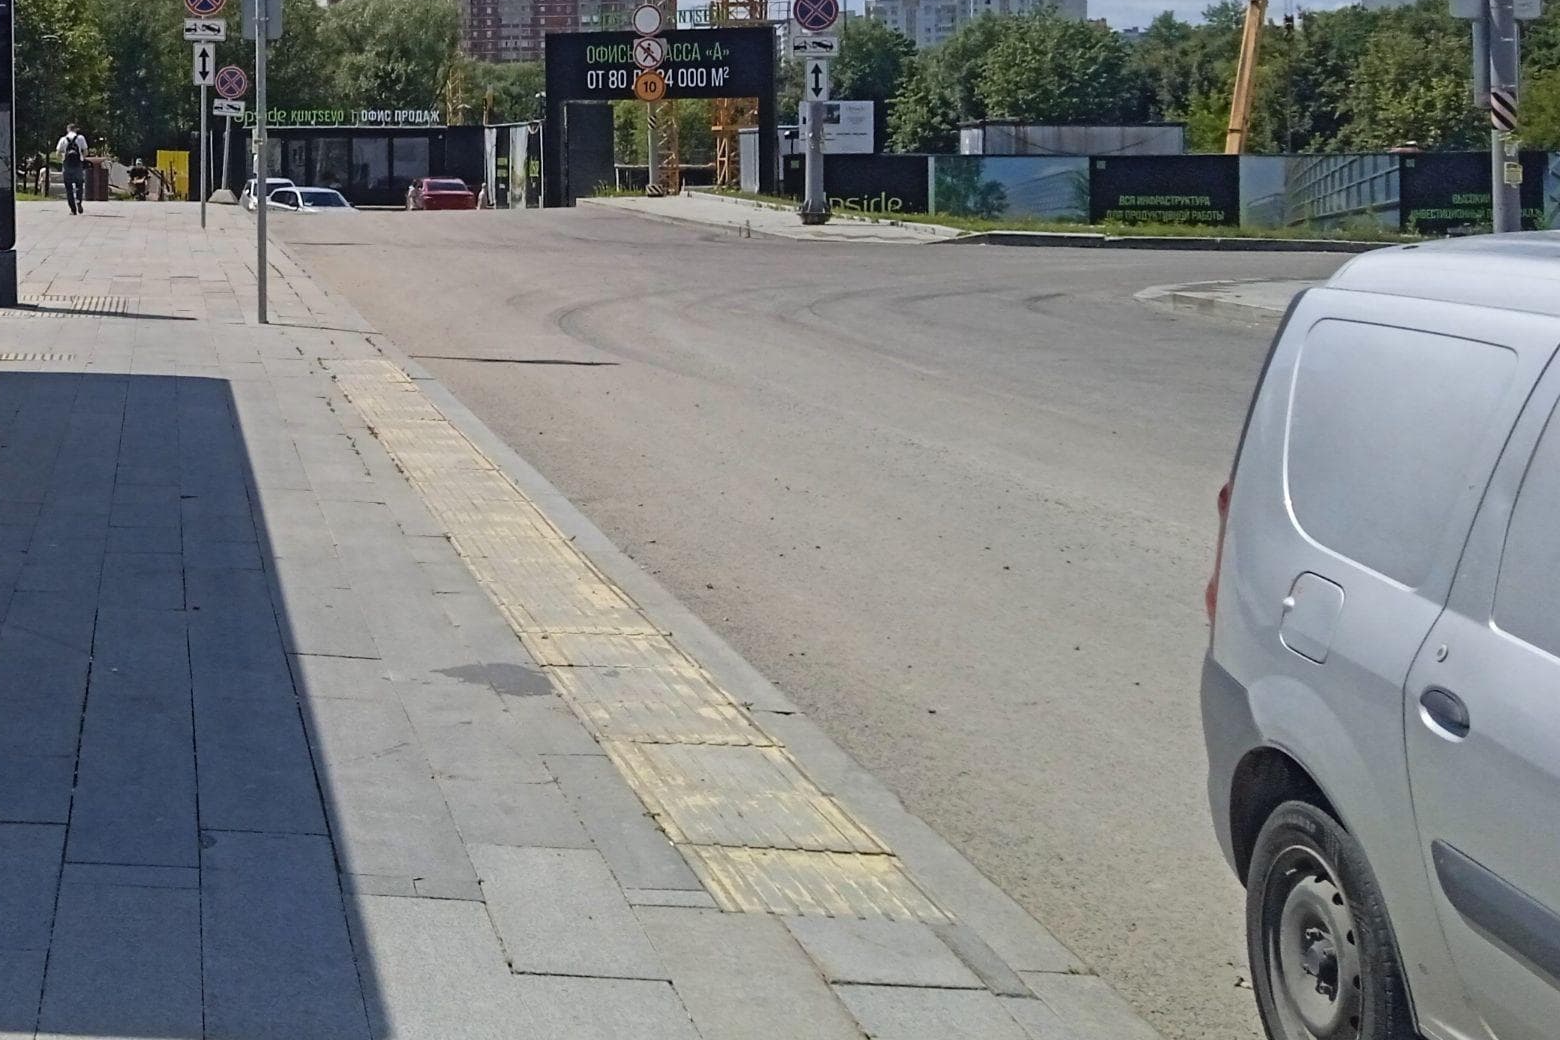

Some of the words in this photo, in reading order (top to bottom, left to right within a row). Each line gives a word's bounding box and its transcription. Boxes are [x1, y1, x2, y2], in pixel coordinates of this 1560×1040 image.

[662, 43, 701, 61] АССА
[705, 42, 730, 61] «А»
[587, 70, 606, 89] ОТ
[608, 69, 627, 89] 80
[678, 68, 706, 87] 000
[643, 81, 657, 93] 10
[291, 110, 344, 122] KUNTSEVO
[361, 110, 391, 122] ОФИС
[395, 110, 440, 123] ПРОДАЖ
